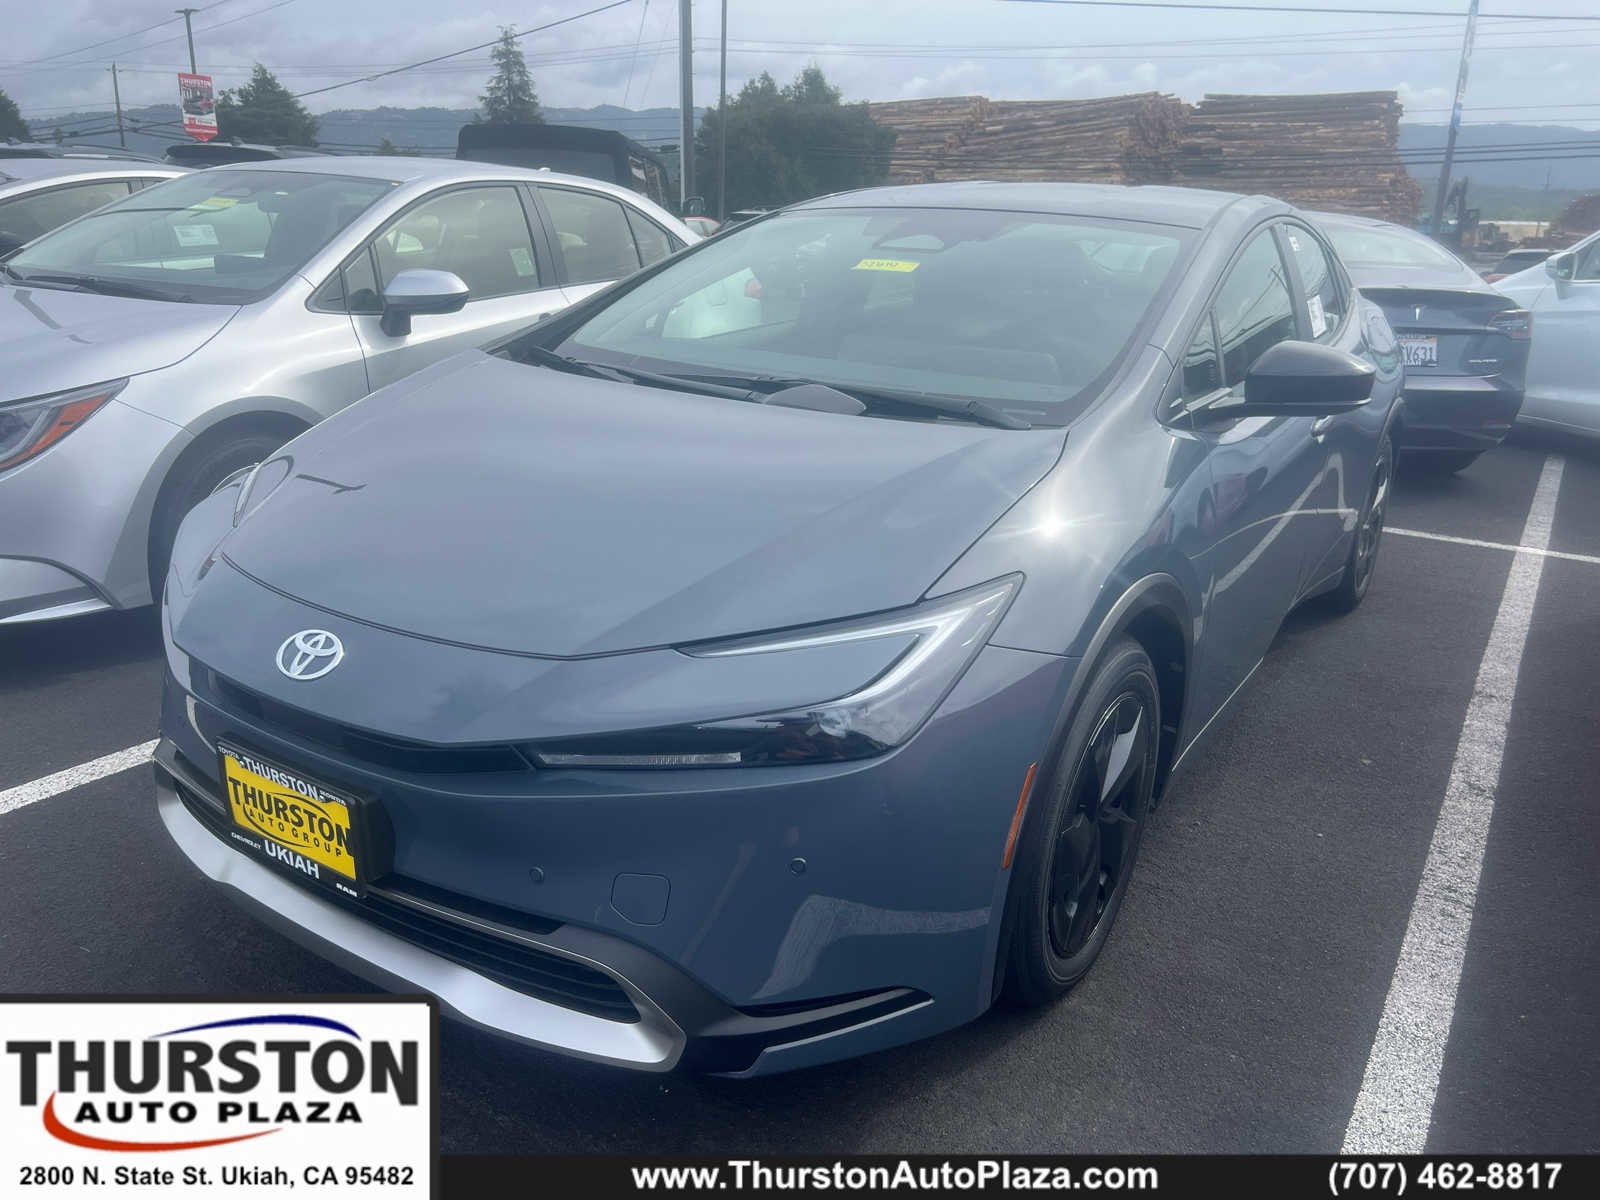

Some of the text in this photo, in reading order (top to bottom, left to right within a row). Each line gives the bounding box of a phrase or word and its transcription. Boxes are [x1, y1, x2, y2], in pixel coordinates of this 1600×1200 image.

[243, 756, 319, 801] THURSTON
[228, 776, 354, 857] THURSTON
[249, 807, 342, 857] AUTO GROUP
[231, 832, 262, 851] CHEVROLET
[264, 839, 320, 879] UKIAH
[335, 882, 358, 897] RAM
